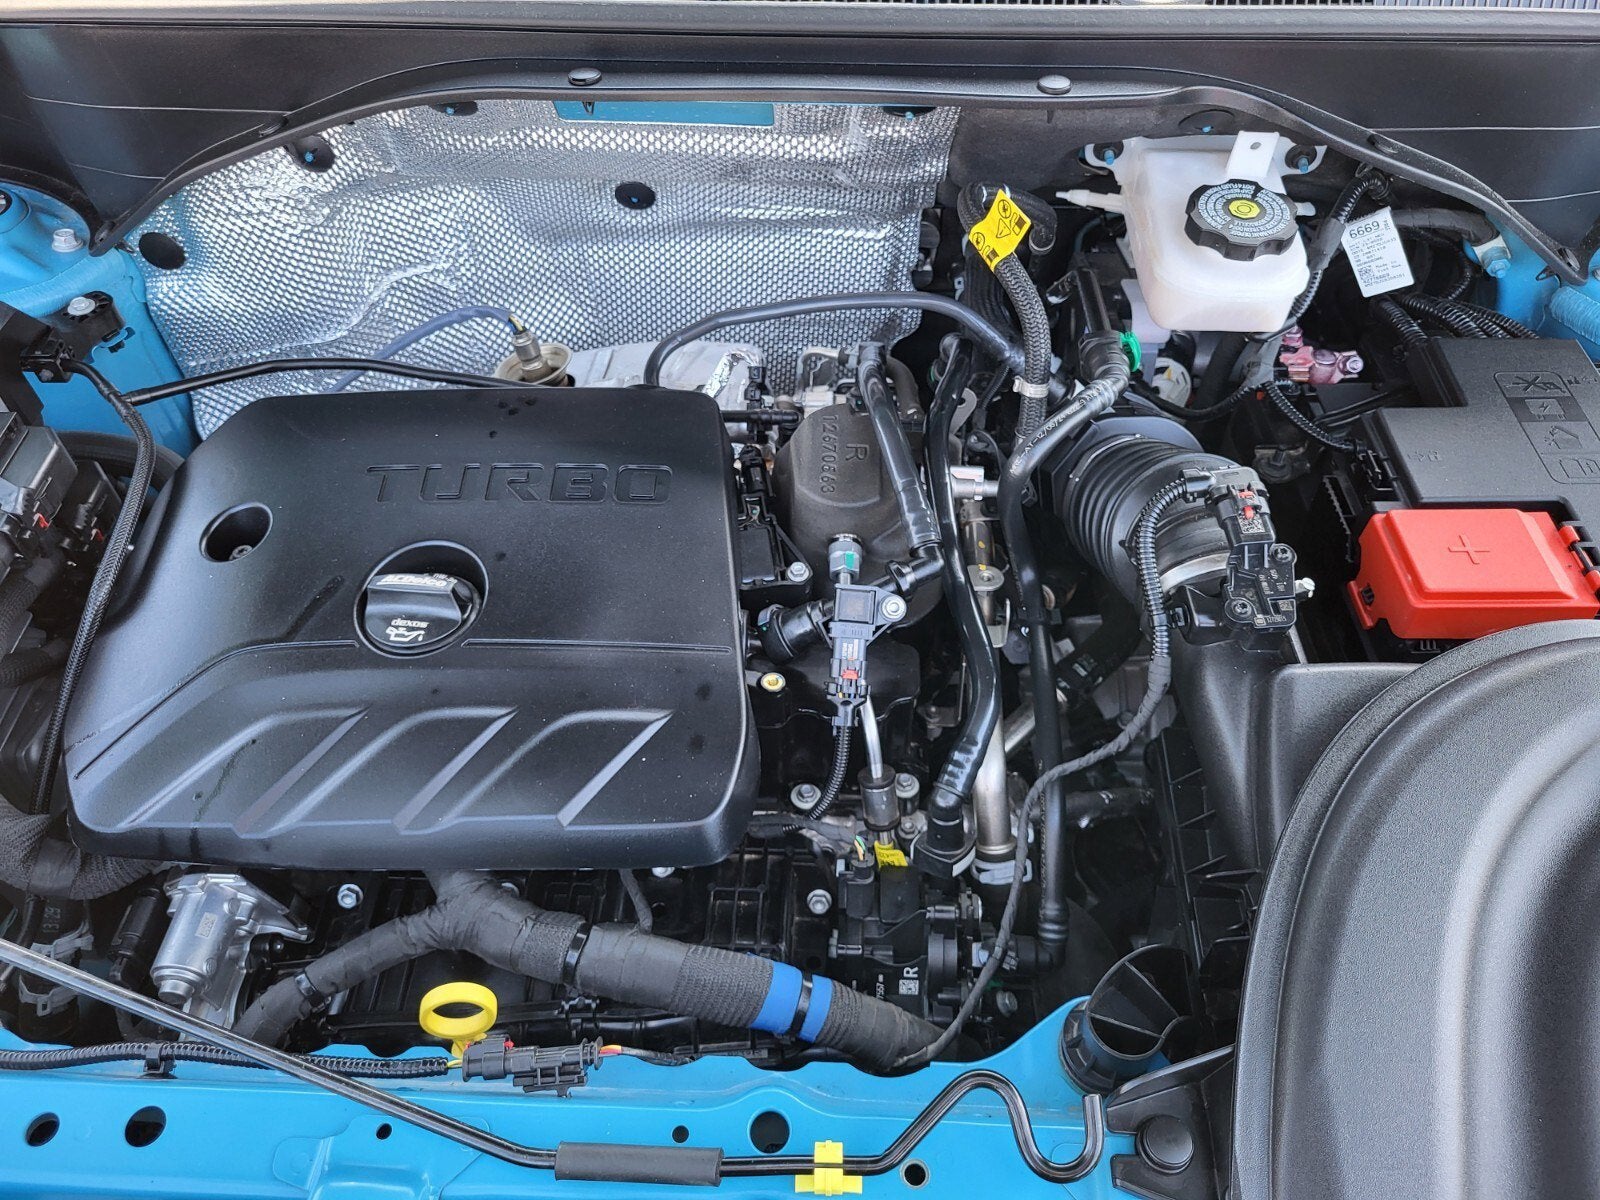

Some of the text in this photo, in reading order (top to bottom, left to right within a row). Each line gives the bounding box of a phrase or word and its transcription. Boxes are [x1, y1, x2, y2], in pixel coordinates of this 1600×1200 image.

[1349, 220, 1380, 239] 6669
[844, 442, 870, 462] R
[366, 461, 673, 504] TURBO
[391, 617, 430, 629] dexos
[903, 966, 919, 979] R
